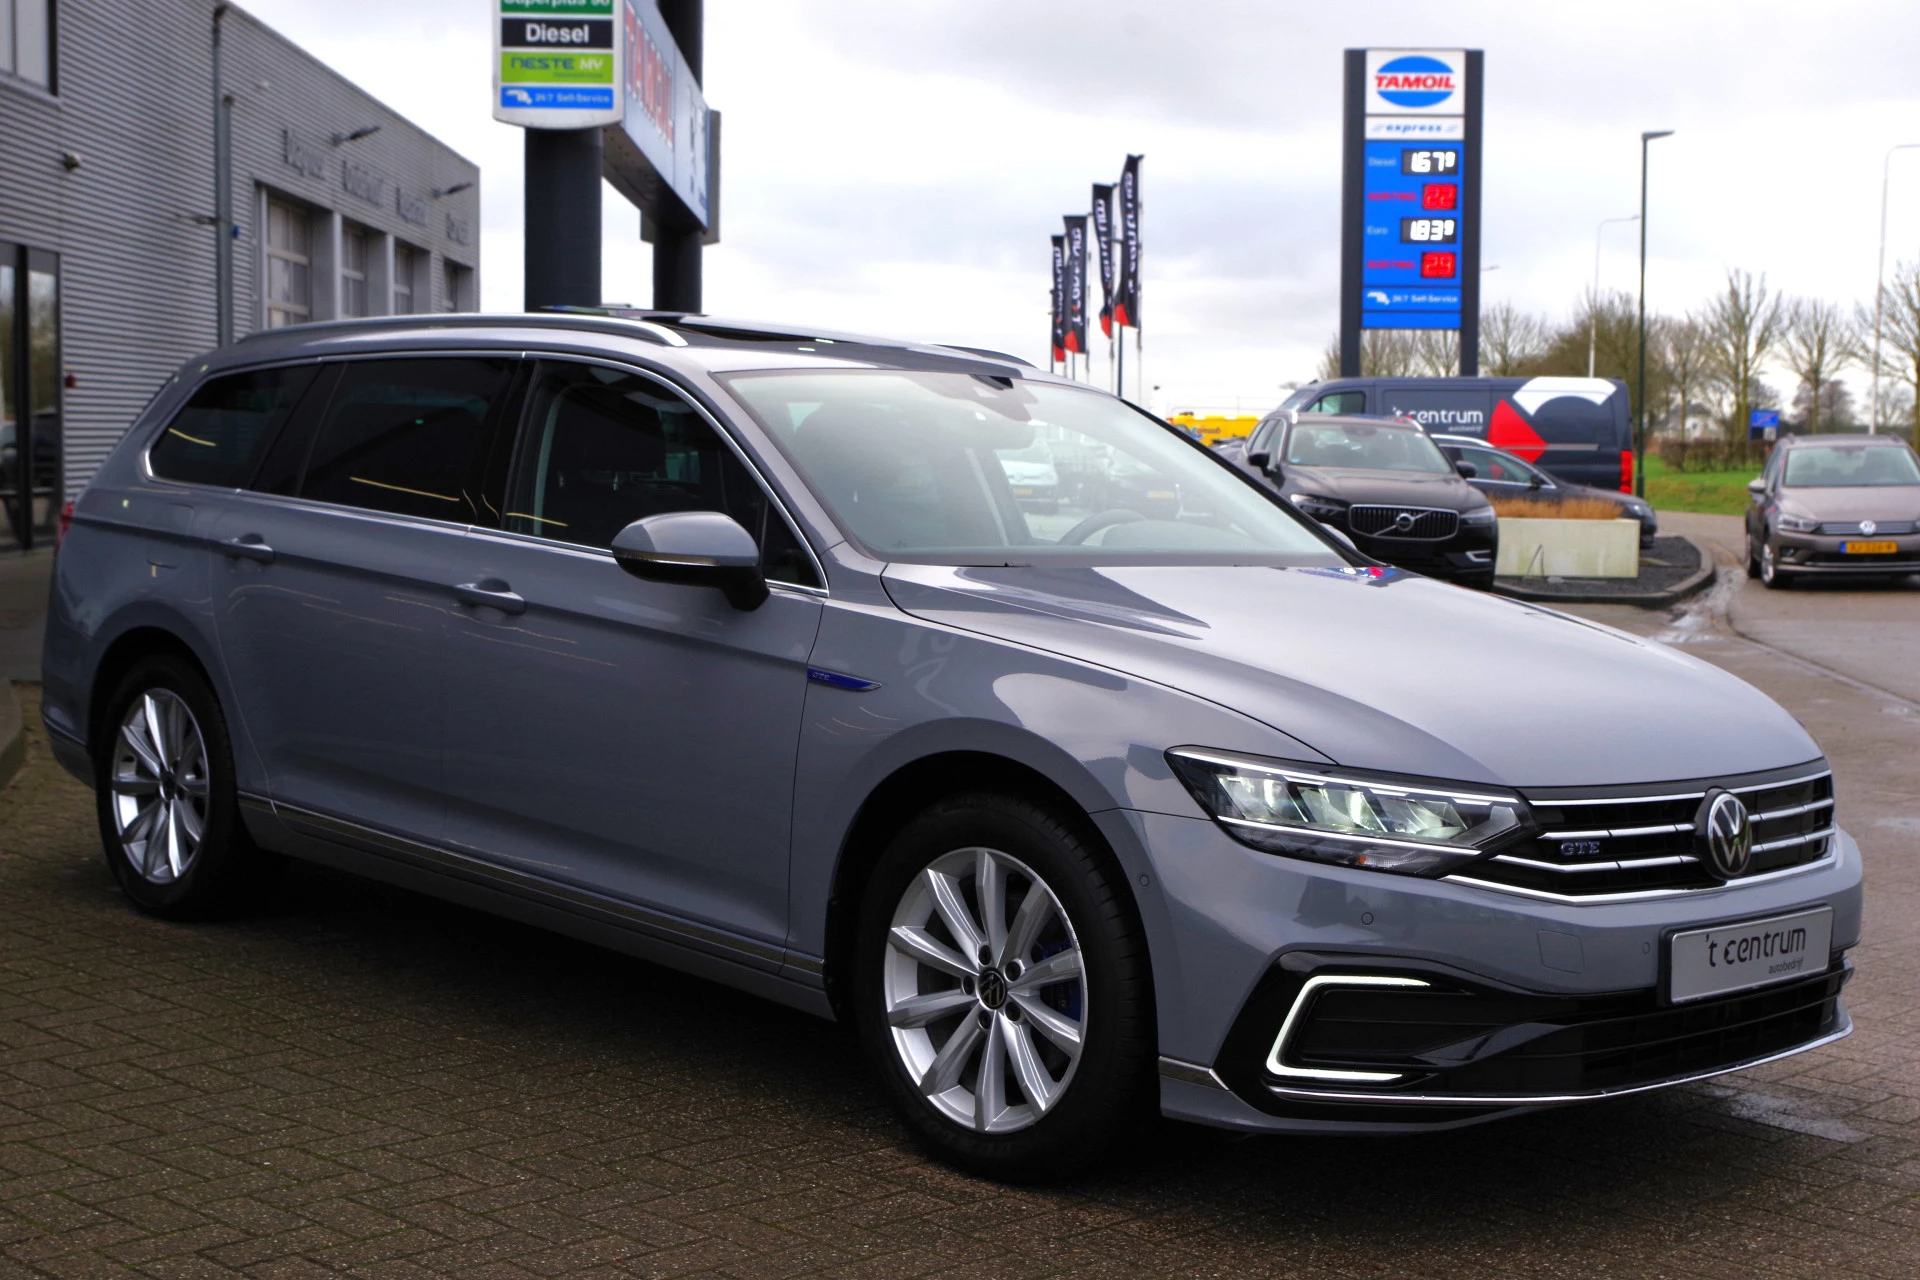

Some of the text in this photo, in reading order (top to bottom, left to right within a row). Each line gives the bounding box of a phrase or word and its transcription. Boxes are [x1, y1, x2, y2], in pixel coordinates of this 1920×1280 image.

[525, 23, 590, 43] Diesel
[1374, 75, 1456, 90] TAMOIL
[1386, 123, 1442, 134] express
[1408, 409, 1484, 424] centrum
[1560, 841, 1601, 857] GTE
[1705, 928, 1806, 968] 't centrum
[1768, 956, 1805, 975] autobedrijf
